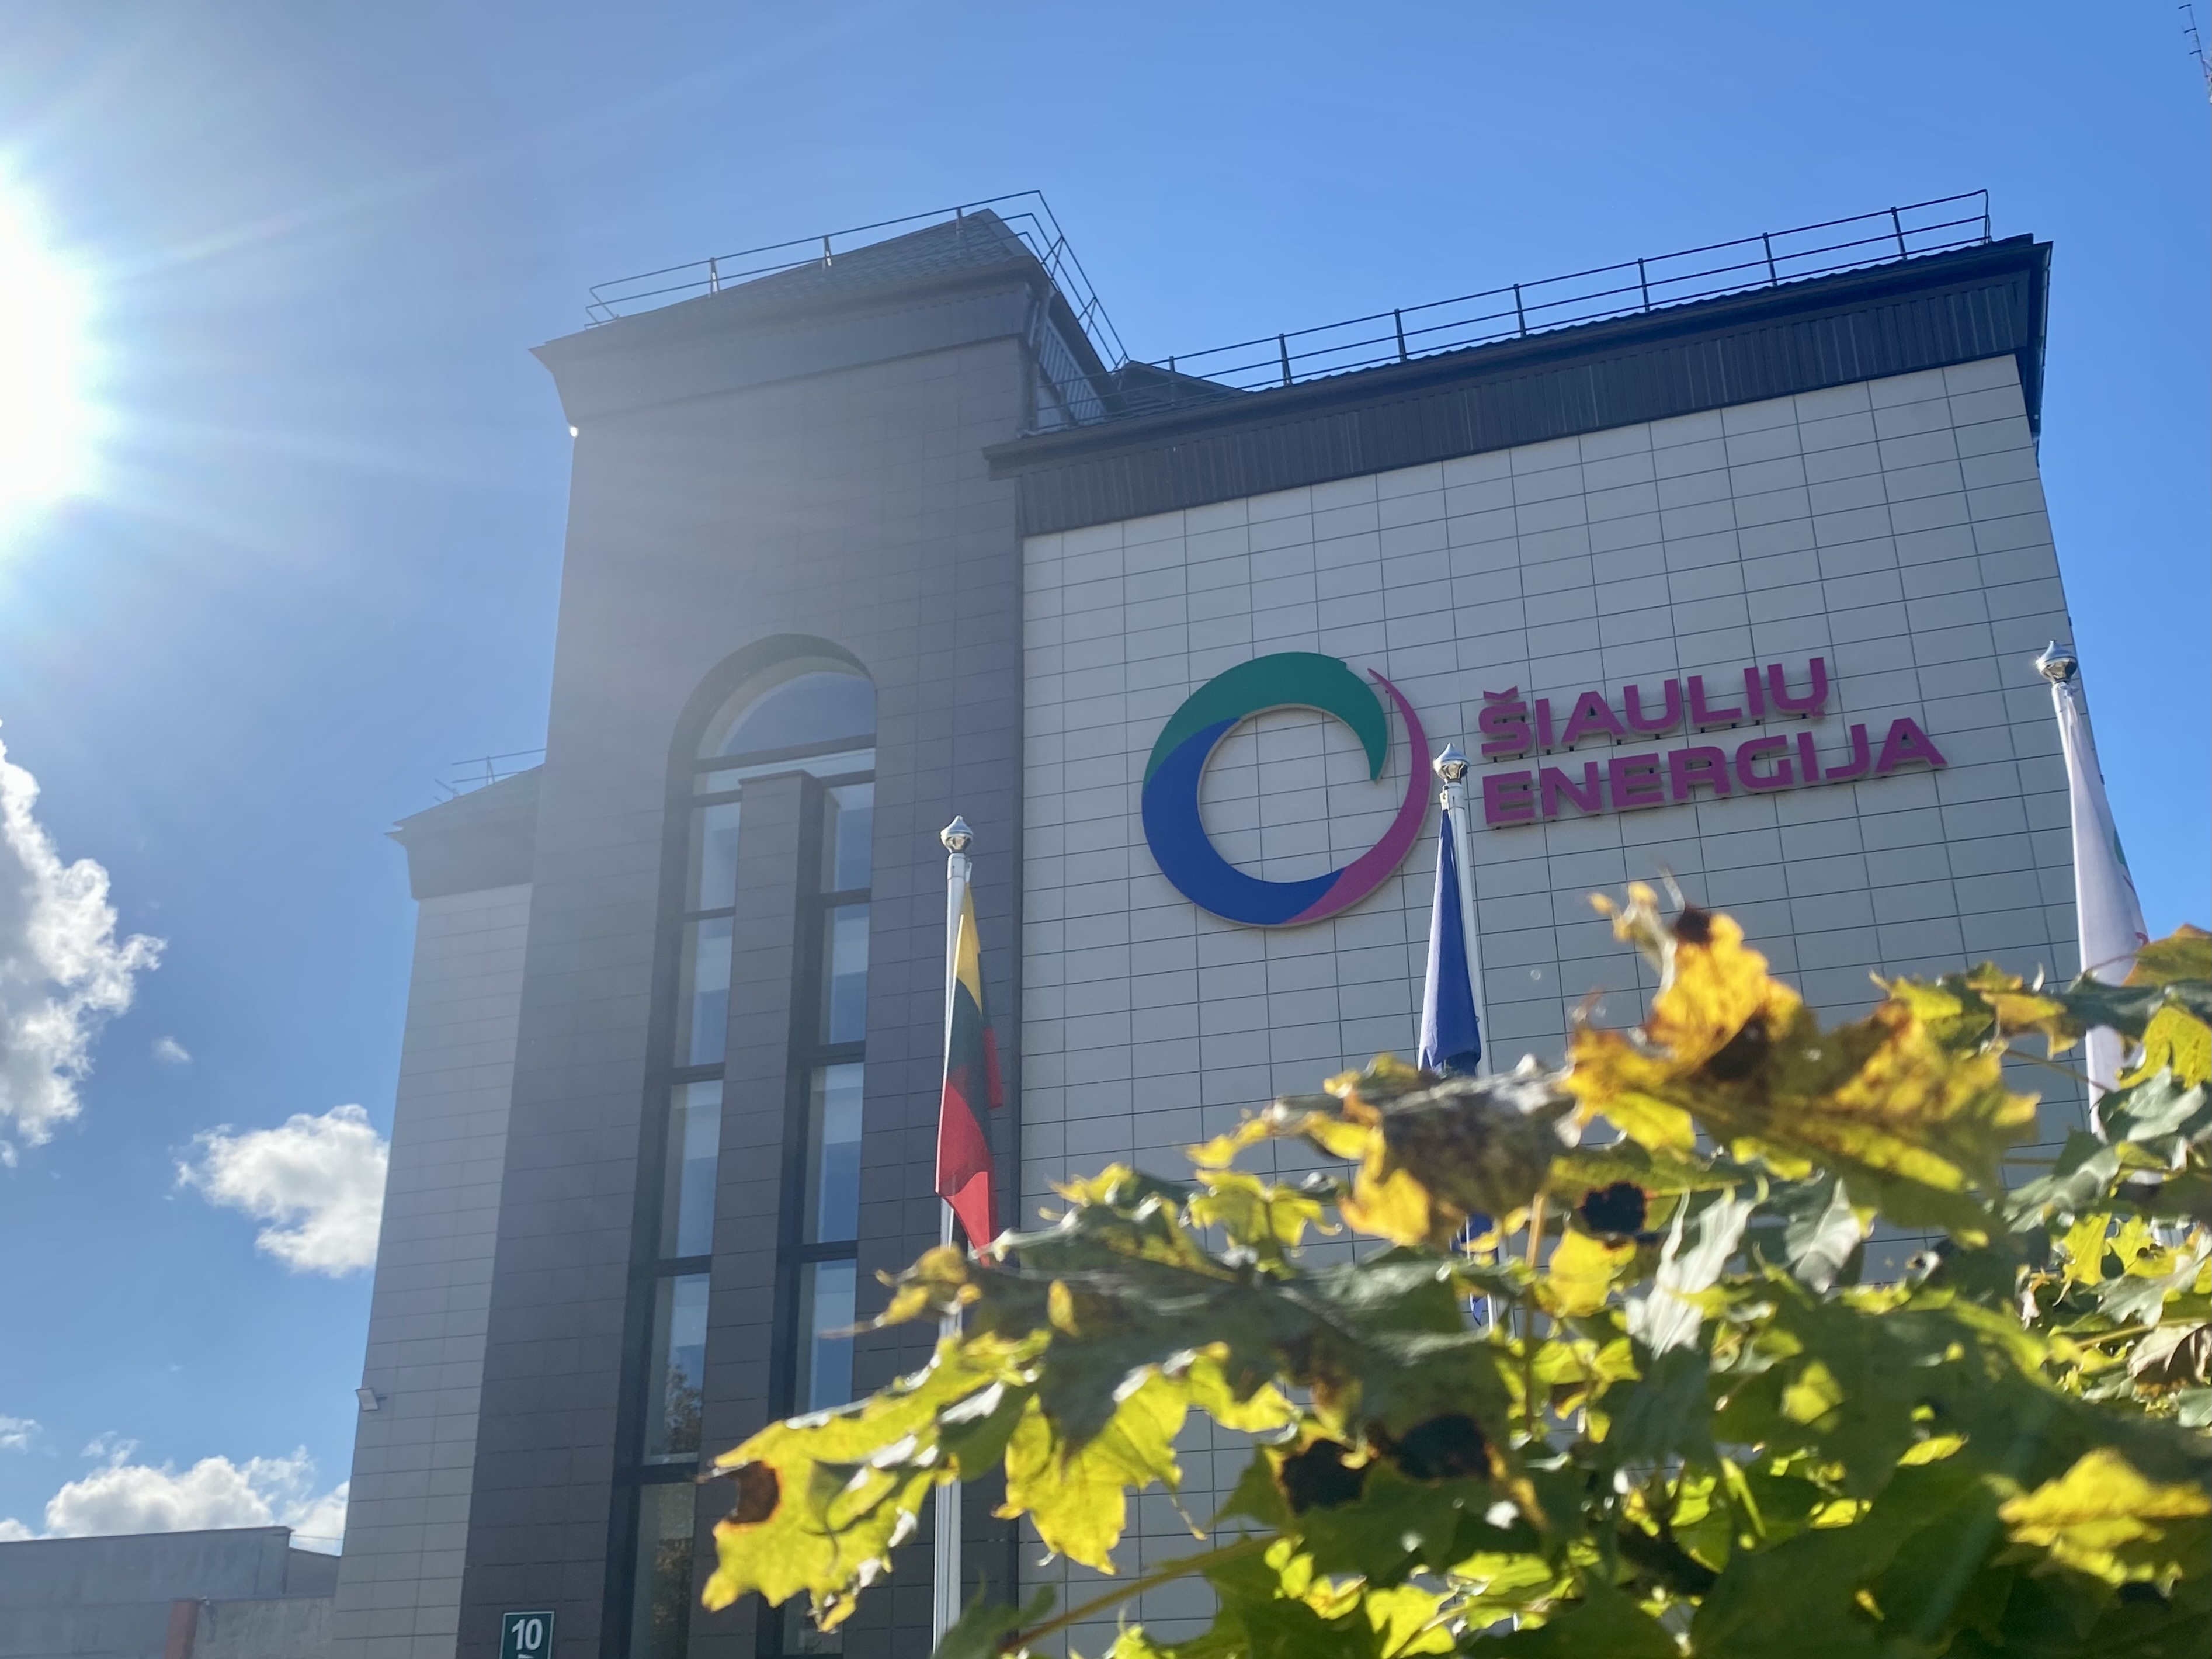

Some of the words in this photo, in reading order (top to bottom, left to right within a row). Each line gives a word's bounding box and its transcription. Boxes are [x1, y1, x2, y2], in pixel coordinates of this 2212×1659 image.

[1478, 657, 1829, 759] ŠIAULIŲ
[1482, 717, 1949, 827] ENERGIJA
[511, 1618, 543, 1650] 10
